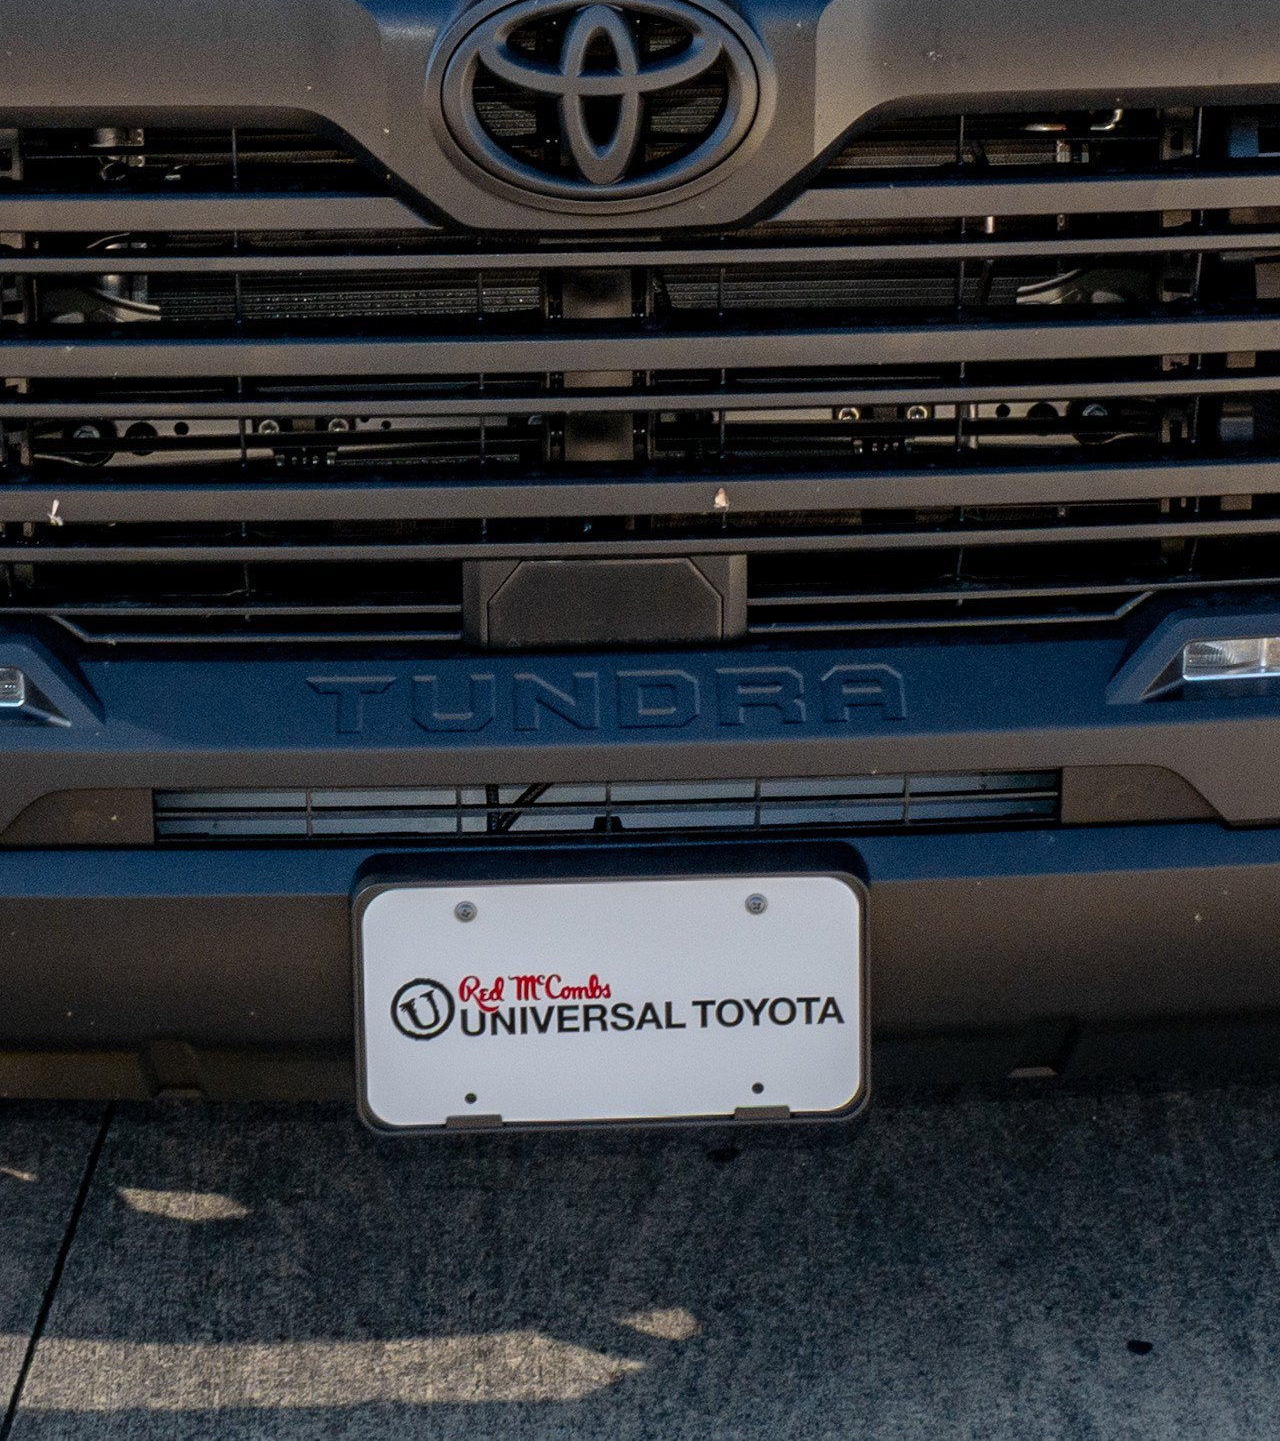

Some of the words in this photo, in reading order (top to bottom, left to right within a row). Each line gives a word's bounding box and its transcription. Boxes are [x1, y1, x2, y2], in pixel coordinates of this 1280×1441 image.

[305, 663, 908, 735] TUNDRA
[458, 974, 504, 1013] Red
[507, 973, 612, 1001] McCombs
[460, 1002, 686, 1037] UNIVERSAL
[691, 995, 845, 1029] TOYOTA
